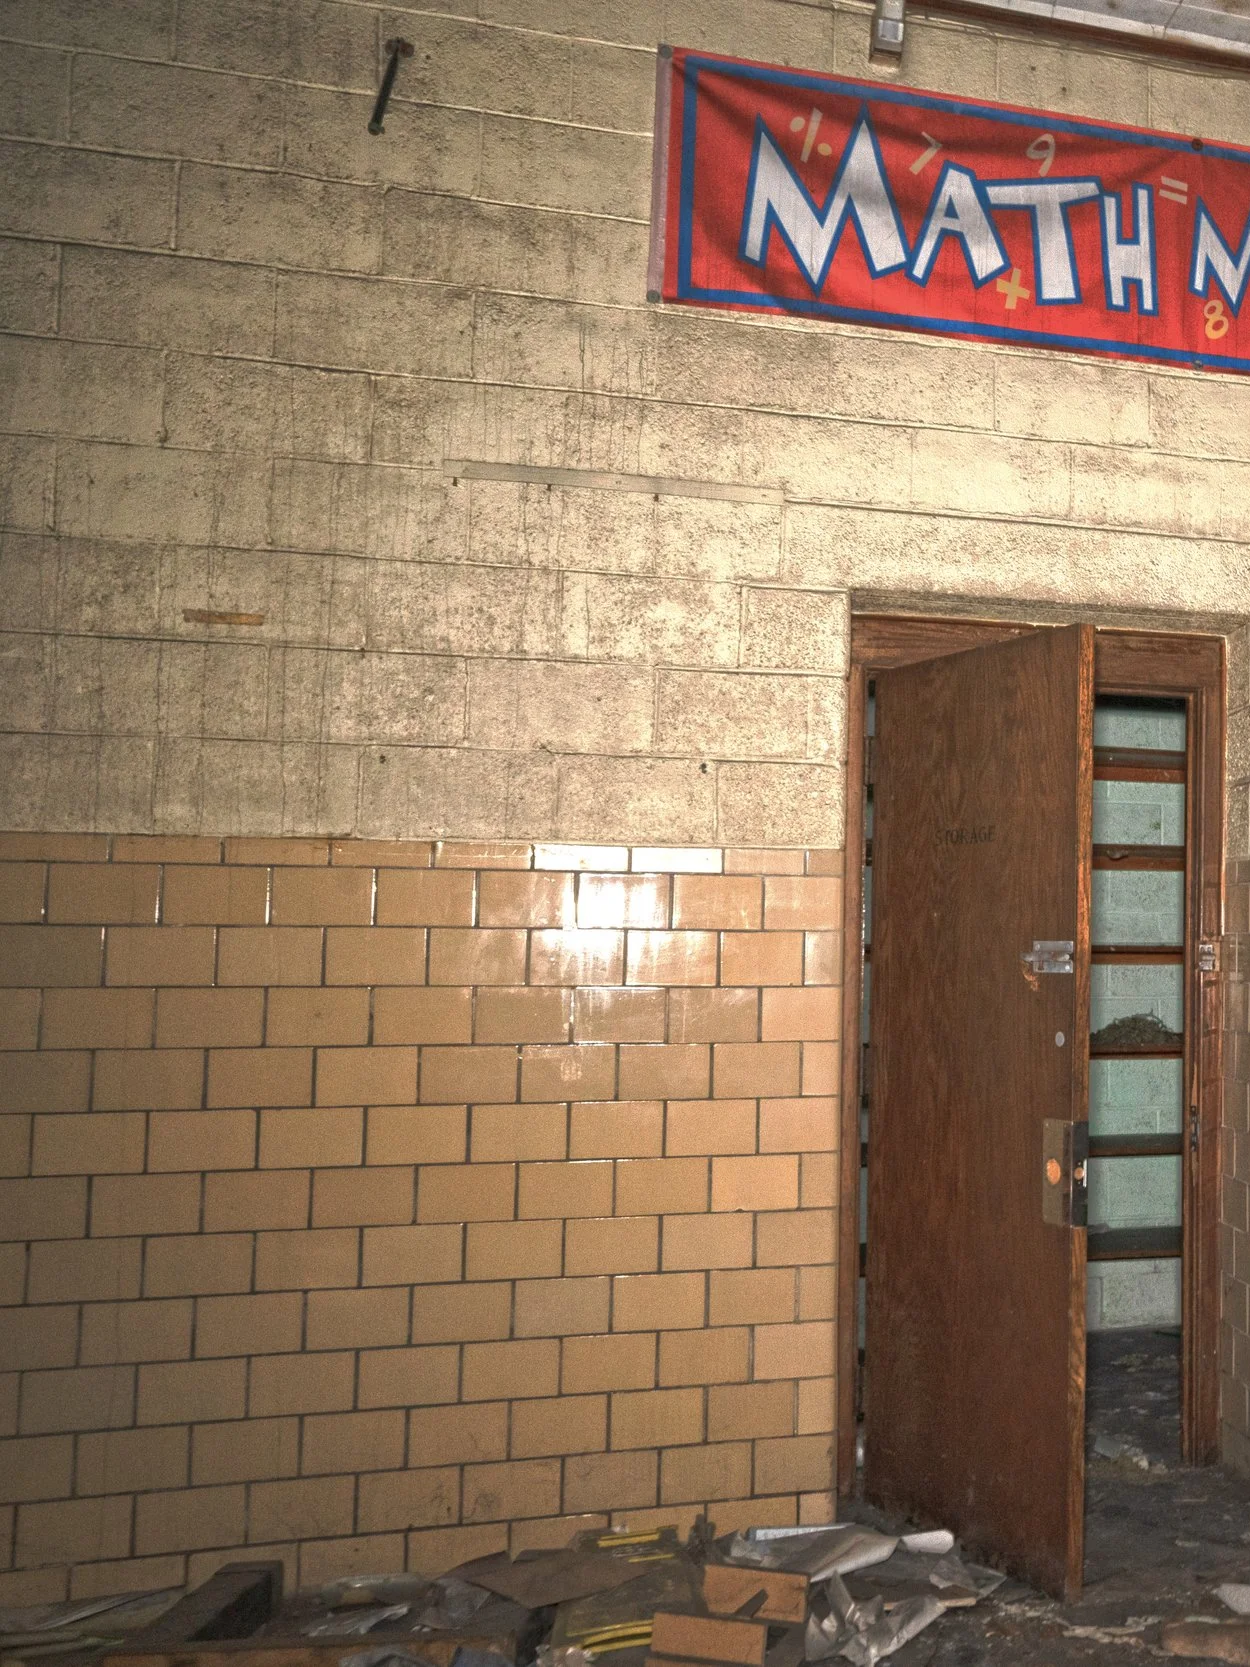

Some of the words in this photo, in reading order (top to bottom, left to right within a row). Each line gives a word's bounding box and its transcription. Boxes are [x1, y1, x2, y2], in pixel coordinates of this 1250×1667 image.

[1026, 132, 1055, 176] 9
[738, 102, 1159, 316] MATH
[1203, 299, 1229, 339] 8
[934, 824, 997, 847] STORAGE
